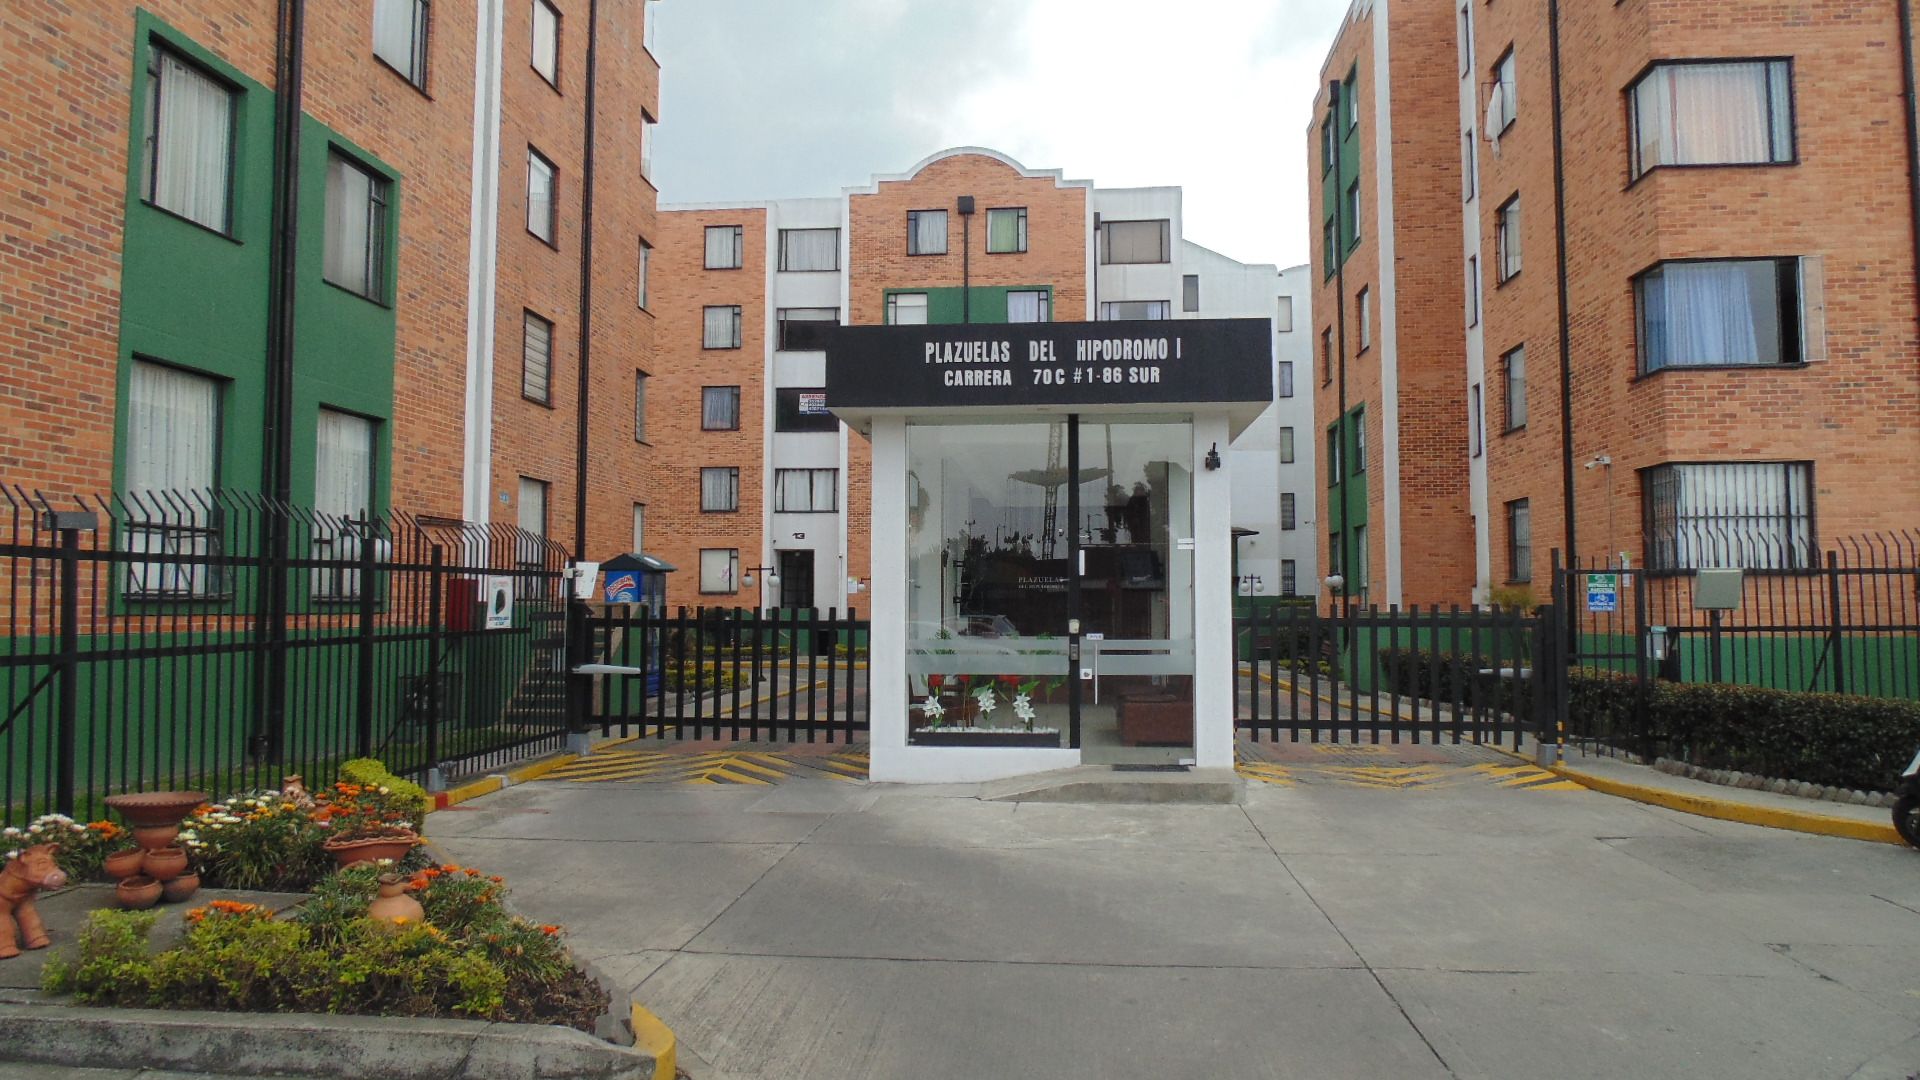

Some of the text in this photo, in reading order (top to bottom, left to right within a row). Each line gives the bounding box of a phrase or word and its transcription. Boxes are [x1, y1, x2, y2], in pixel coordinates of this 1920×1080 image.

[925, 337, 1181, 363] PLAZUELAS DEL HIPODROMO I
[944, 369, 1012, 386] CARRERA
[1129, 366, 1160, 383] SUR
